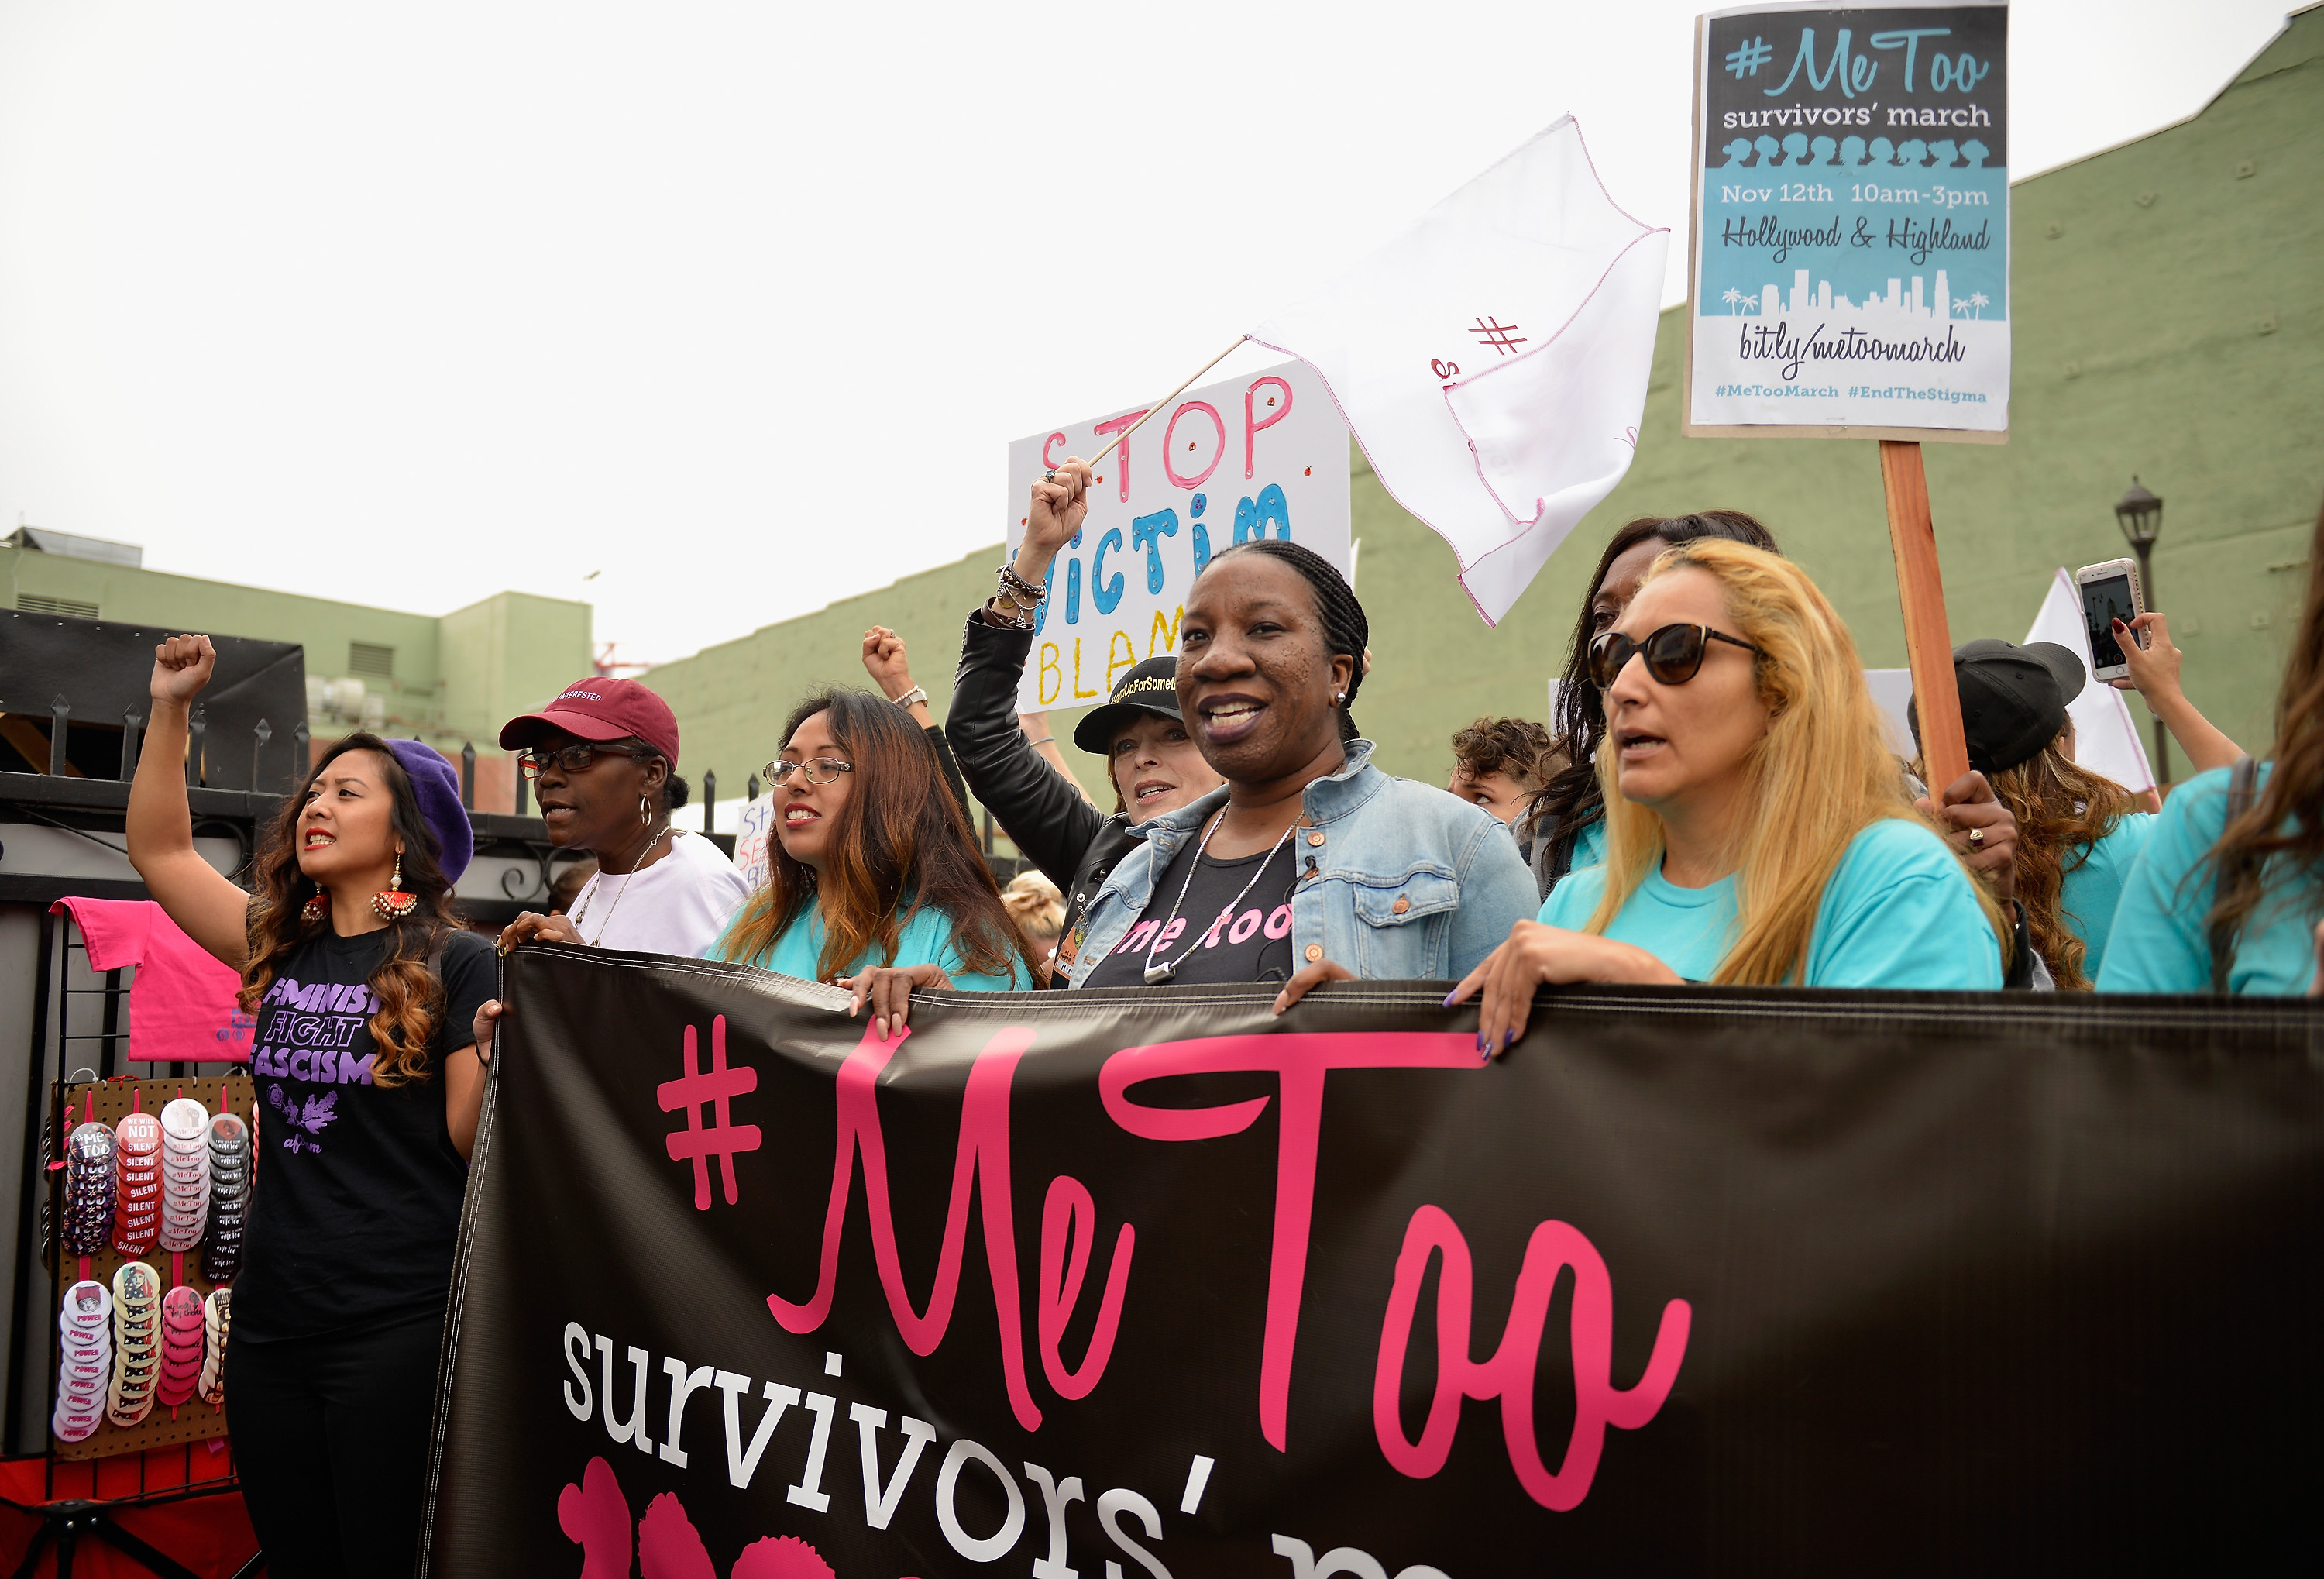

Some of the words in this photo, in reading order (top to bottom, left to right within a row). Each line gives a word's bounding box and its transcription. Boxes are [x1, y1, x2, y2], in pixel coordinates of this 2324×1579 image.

[1870, 28, 1989, 94] Too
[1723, 102, 1879, 129] survivors'
[1886, 104, 1991, 127] march
[1721, 185, 1772, 203] Nov
[1780, 184, 1833, 203] 12th
[1851, 184, 1989, 210] 10am-3pm
[1722, 215, 1842, 263] Hollywood
[1851, 216, 1876, 248] &
[1886, 218, 1990, 266] Highland
[1739, 322, 1965, 380] bit.ly/metoomarch
[1715, 384, 1839, 399] #MeTooMarch
[1848, 385, 1987, 404] #EndTheStigma
[1110, 916, 1188, 955] me
[1204, 903, 1293, 949] too
[263, 1010, 365, 1047] FIGHT
[128, 1125, 155, 1138] NOT
[128, 1143, 155, 1151] SILENT
[126, 1158, 154, 1167] SILENT
[126, 1172, 155, 1182] SILENT
[130, 1183, 158, 1198] SILENT
[127, 1201, 156, 1212] SILENT
[127, 1213, 155, 1228] SILENT
[127, 1227, 154, 1240] SILENT
[117, 1241, 145, 1254] SILENT
[1098, 1030, 1692, 1512] Too
[69, 1330, 94, 1340] POWER
[70, 1380, 95, 1388] POWER
[67, 1395, 92, 1405] POWER
[563, 1320, 1215, 1578] survivors'
